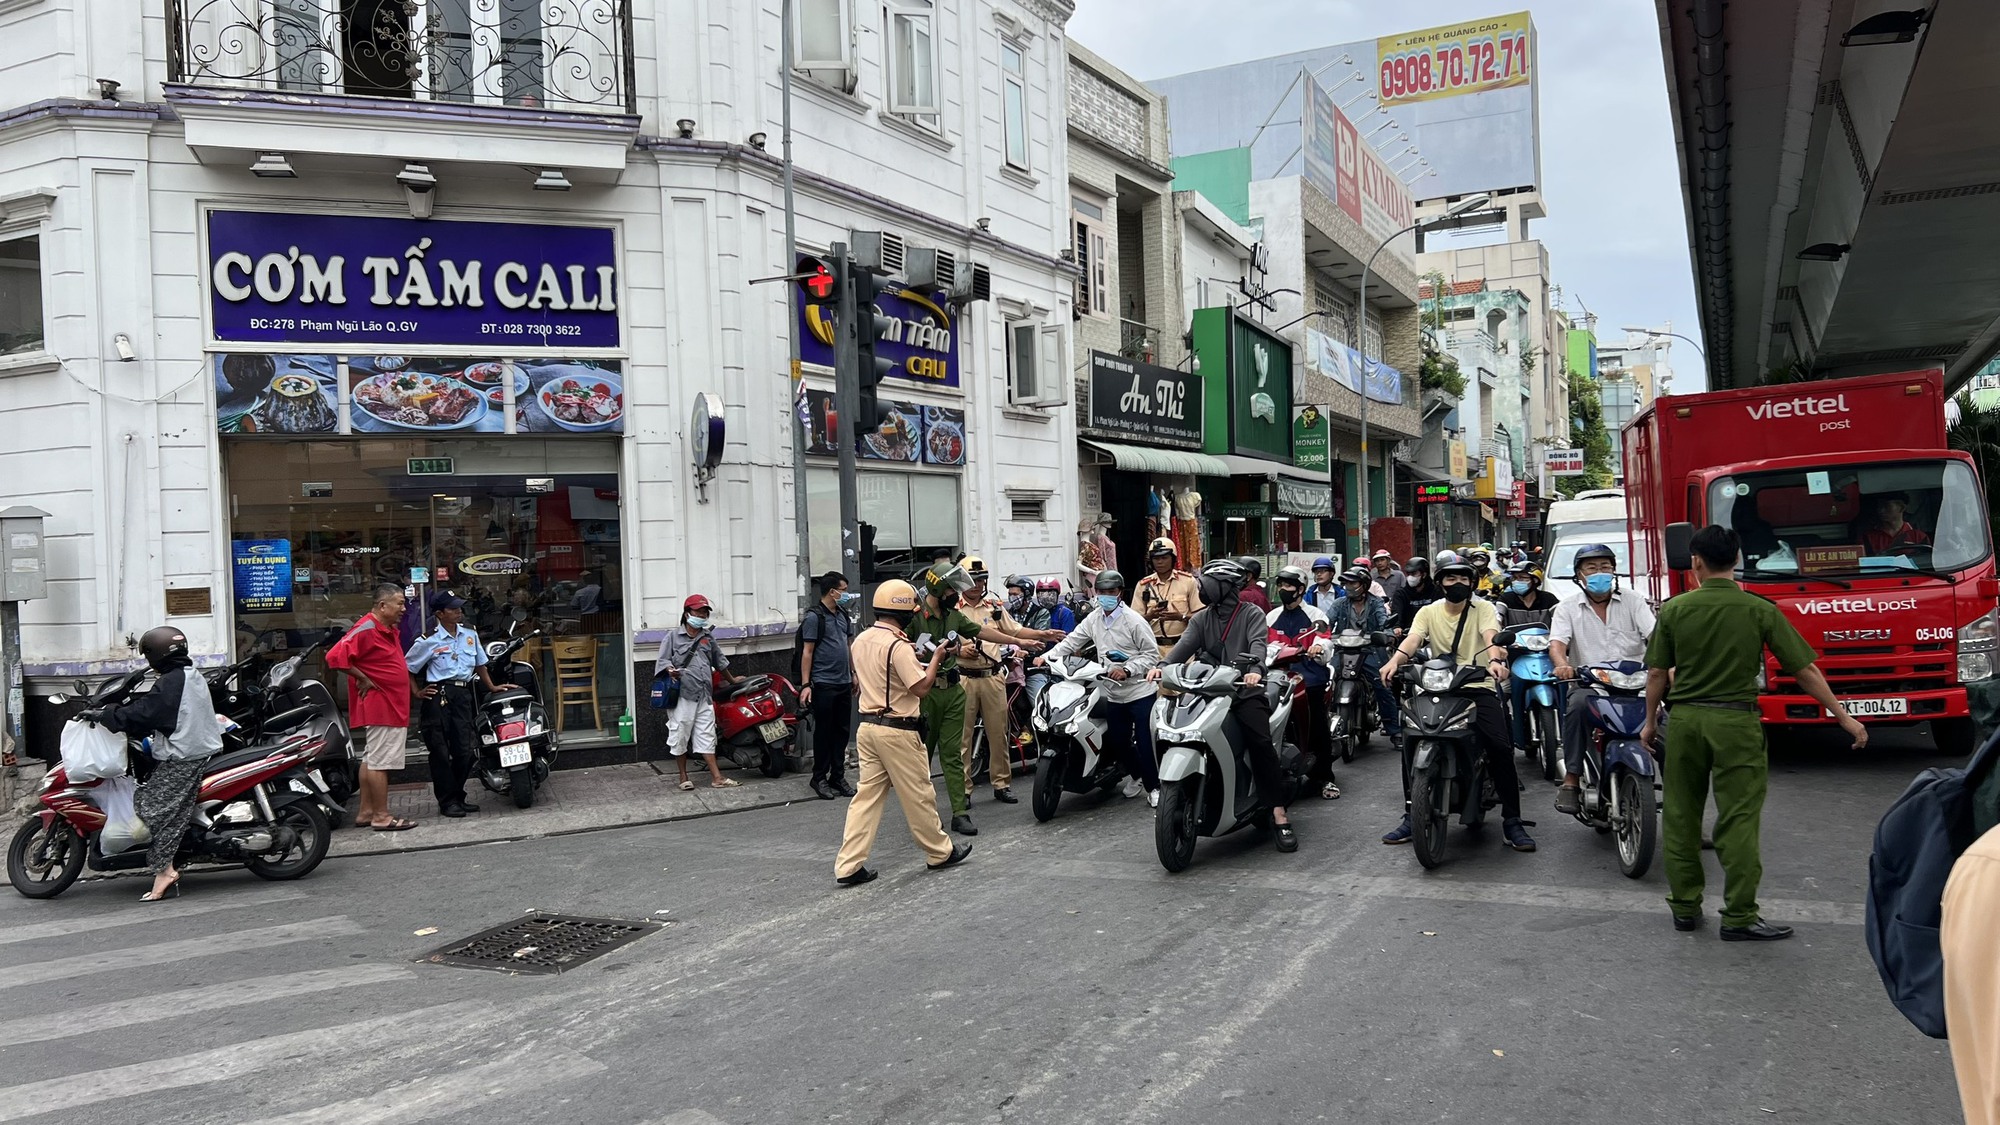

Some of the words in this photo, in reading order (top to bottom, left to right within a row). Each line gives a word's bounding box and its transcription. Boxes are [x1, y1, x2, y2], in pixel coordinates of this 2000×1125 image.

[1405, 36, 1426, 46] LIÊN
[1428, 33, 1441, 43] HỆ
[1381, 36, 1527, 99] 0908.70.72.71
[1360, 147, 1413, 237] KYMDAN
[213, 245, 347, 305] CƠM
[362, 237, 484, 307] TẤM
[494, 261, 616, 311] CALI
[300, 319, 333, 333] Phạm
[336, 320, 359, 333] Ngũ
[361, 321, 383, 331] Lão
[386, 321, 418, 333] Q.GV
[526, 324, 552, 335] 7300
[555, 325, 581, 335] 3622
[906, 356, 947, 379] CALI
[1120, 373, 1152, 415] An
[1820, 419, 1851, 432] post
[1295, 439, 1326, 447] MONKEY
[1299, 454, 1324, 462] 12.000
[411, 460, 449, 473] EXIT
[891, 596, 912, 605] CSGT
[1878, 598, 1918, 613] post
[1823, 629, 1891, 642] ISUZU
[1916, 627, 1954, 641] 05-LOG
[1839, 697, 1902, 715] KT-004.12
